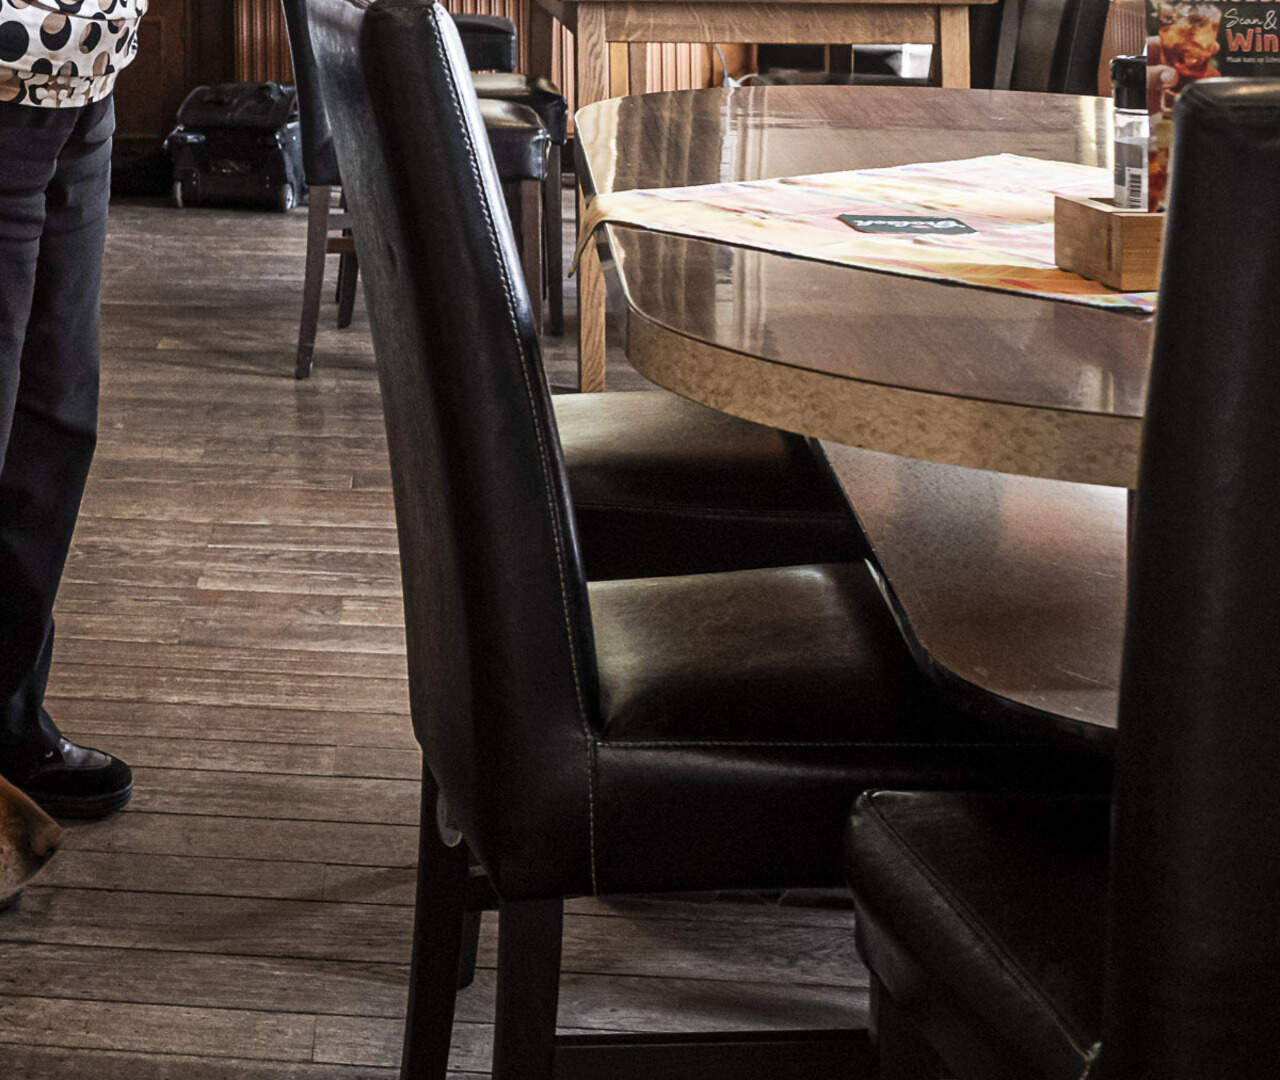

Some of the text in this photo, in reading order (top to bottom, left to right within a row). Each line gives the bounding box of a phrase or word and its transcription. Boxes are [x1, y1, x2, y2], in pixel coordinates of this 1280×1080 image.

[1224, 8, 1278, 30] Scan &
[1225, 27, 1280, 52] Win
